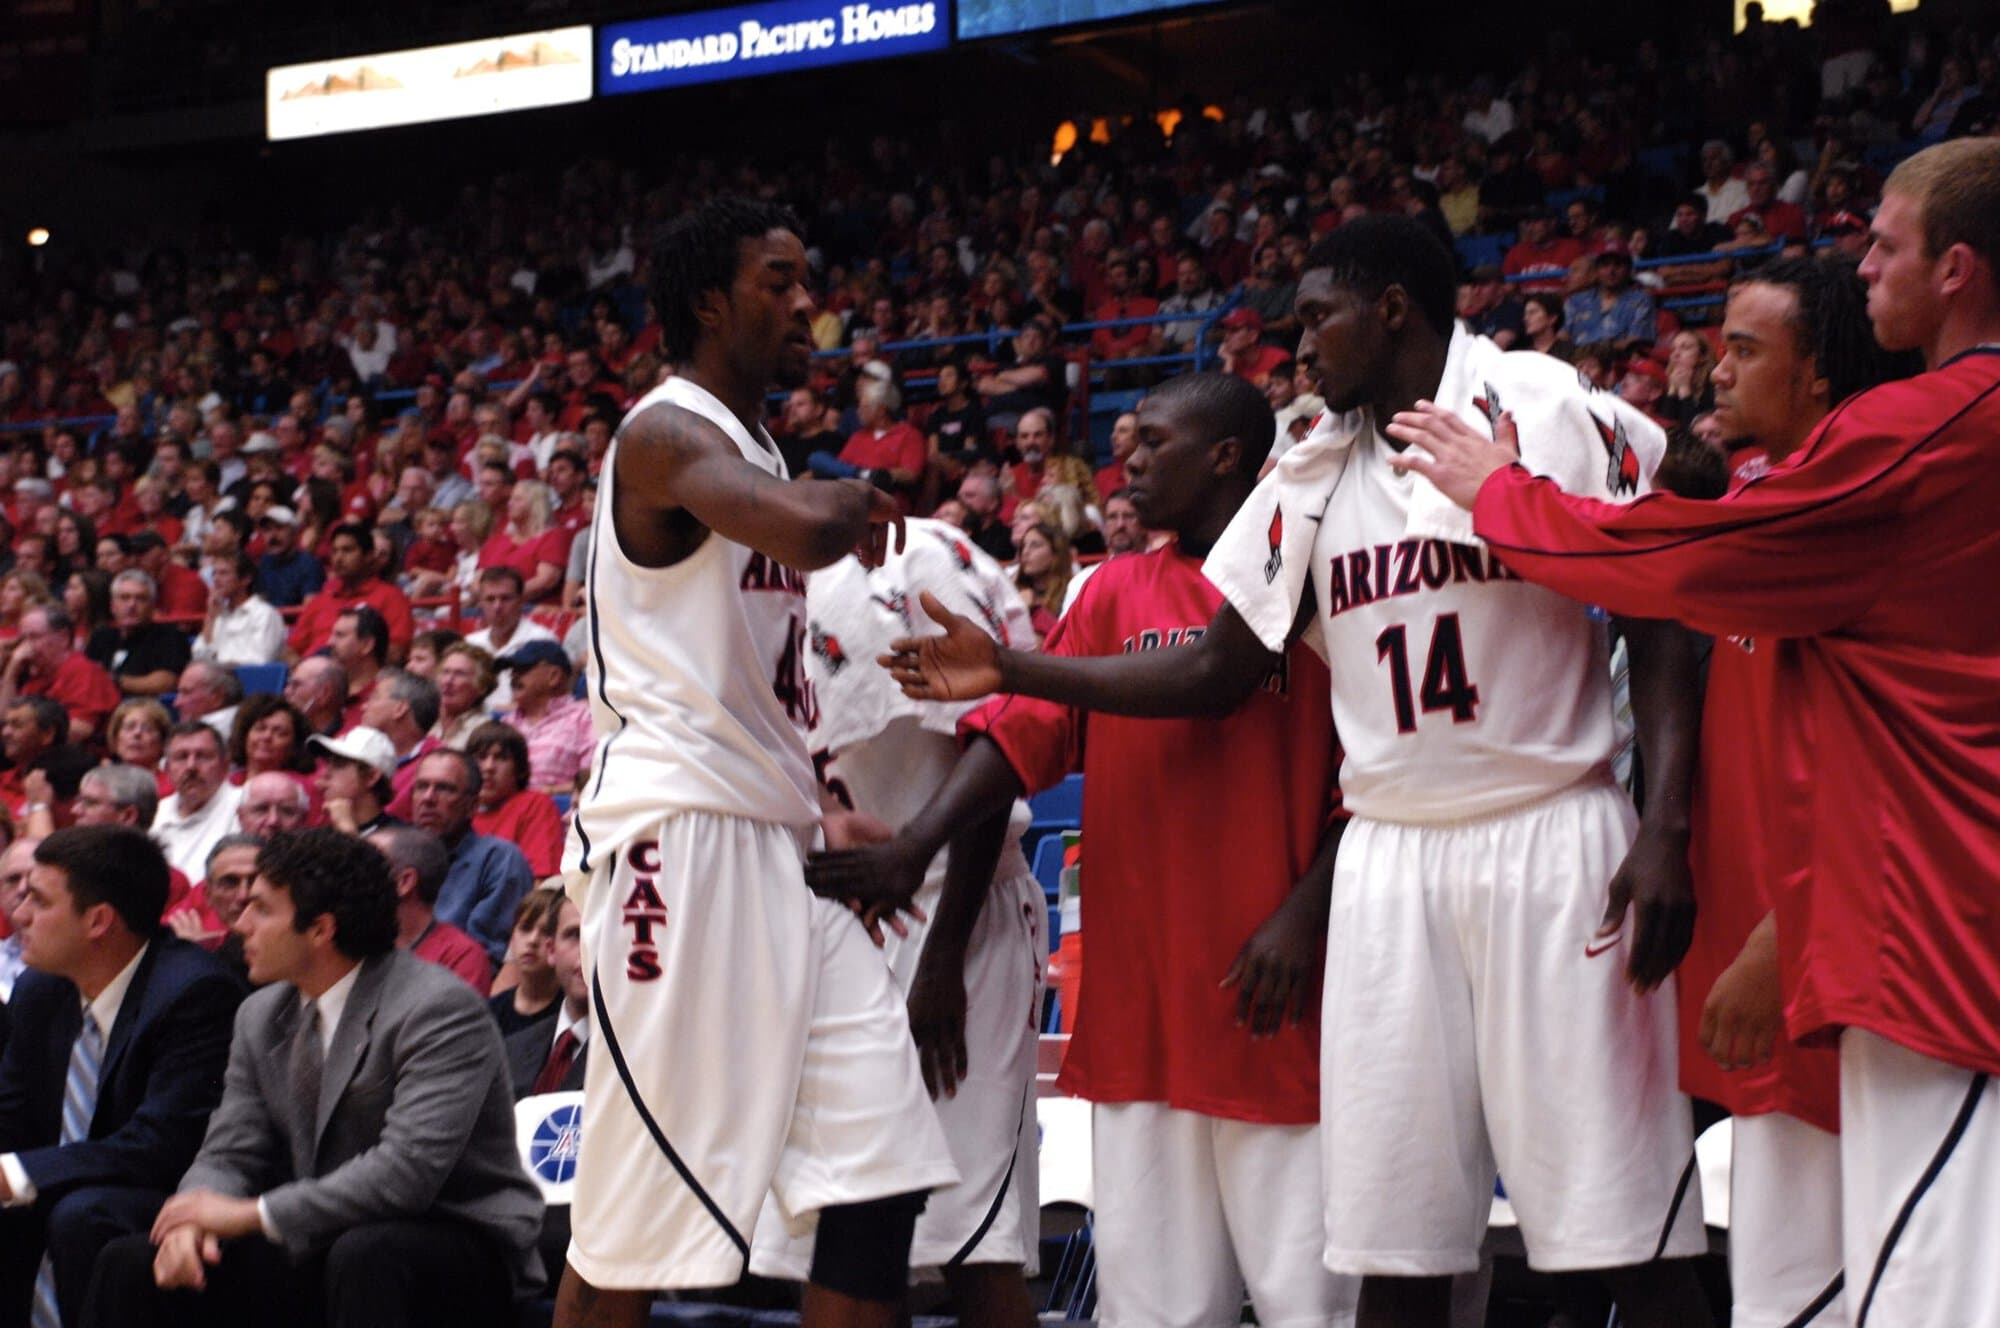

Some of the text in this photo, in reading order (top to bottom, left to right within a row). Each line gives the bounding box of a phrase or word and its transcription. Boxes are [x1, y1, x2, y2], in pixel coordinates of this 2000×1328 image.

[610, 2, 936, 77] STANDARD PACIFIC HOMES
[1375, 611, 1480, 734] 14
[622, 840, 668, 982] CATS
